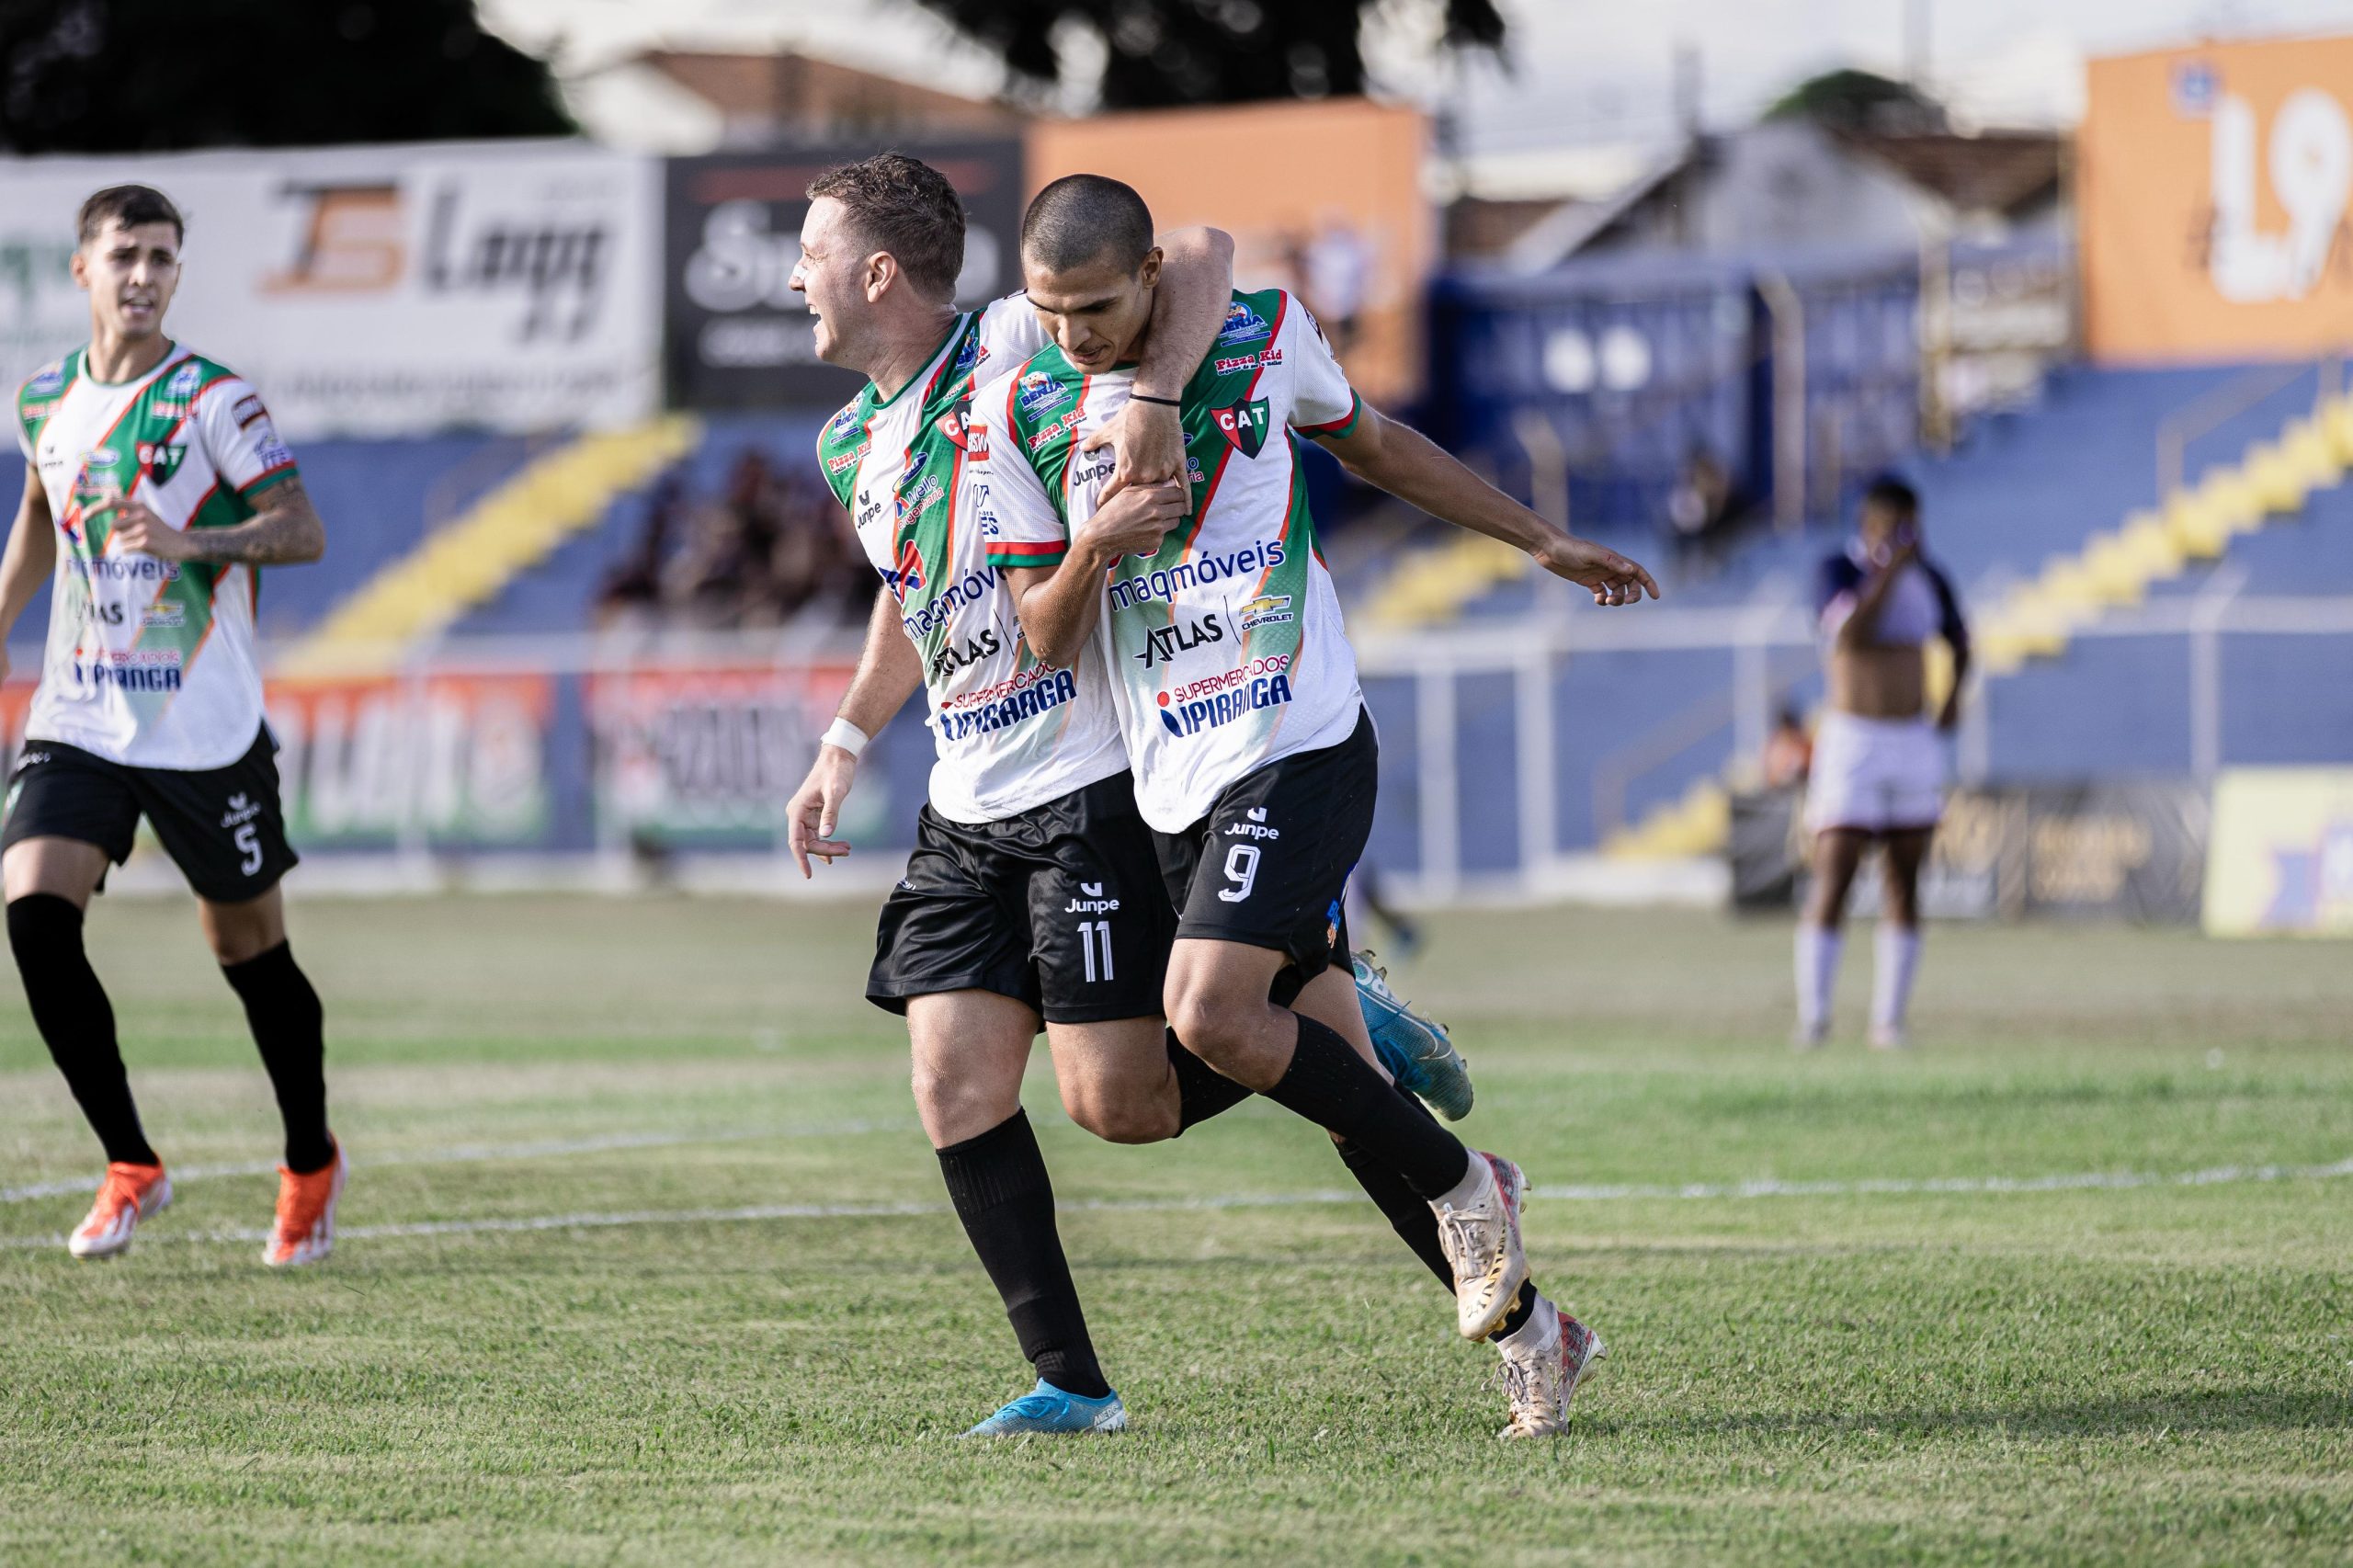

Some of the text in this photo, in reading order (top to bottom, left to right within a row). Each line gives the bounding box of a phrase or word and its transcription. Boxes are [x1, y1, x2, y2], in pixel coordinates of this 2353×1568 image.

[1215, 349, 1283, 370] Pizza Kid
[1020, 381, 1066, 407] BENJA
[944, 411, 971, 437] CA
[1029, 424, 1061, 449] Pizza
[1061, 407, 1086, 426] Kid
[1220, 406, 1265, 431] CAT
[138, 446, 183, 464] CAT
[827, 451, 856, 470] Pizza
[858, 441, 871, 456] Kid
[1074, 463, 1116, 486] Junpe
[906, 475, 938, 506] Mello
[858, 502, 881, 529] Junpe
[1108, 540, 1285, 611] maqmóveis
[1133, 613, 1292, 669] ATLAS CHEVROLET
[1174, 654, 1290, 704] SUPERMERCADOS
[1179, 674, 1293, 735] IPIRANGA
[1224, 823, 1279, 841] Junpe
[234, 824, 264, 877] 5
[1218, 844, 1261, 903] 9
[1064, 898, 1120, 915] Junpe
[1077, 920, 1114, 983] 11
